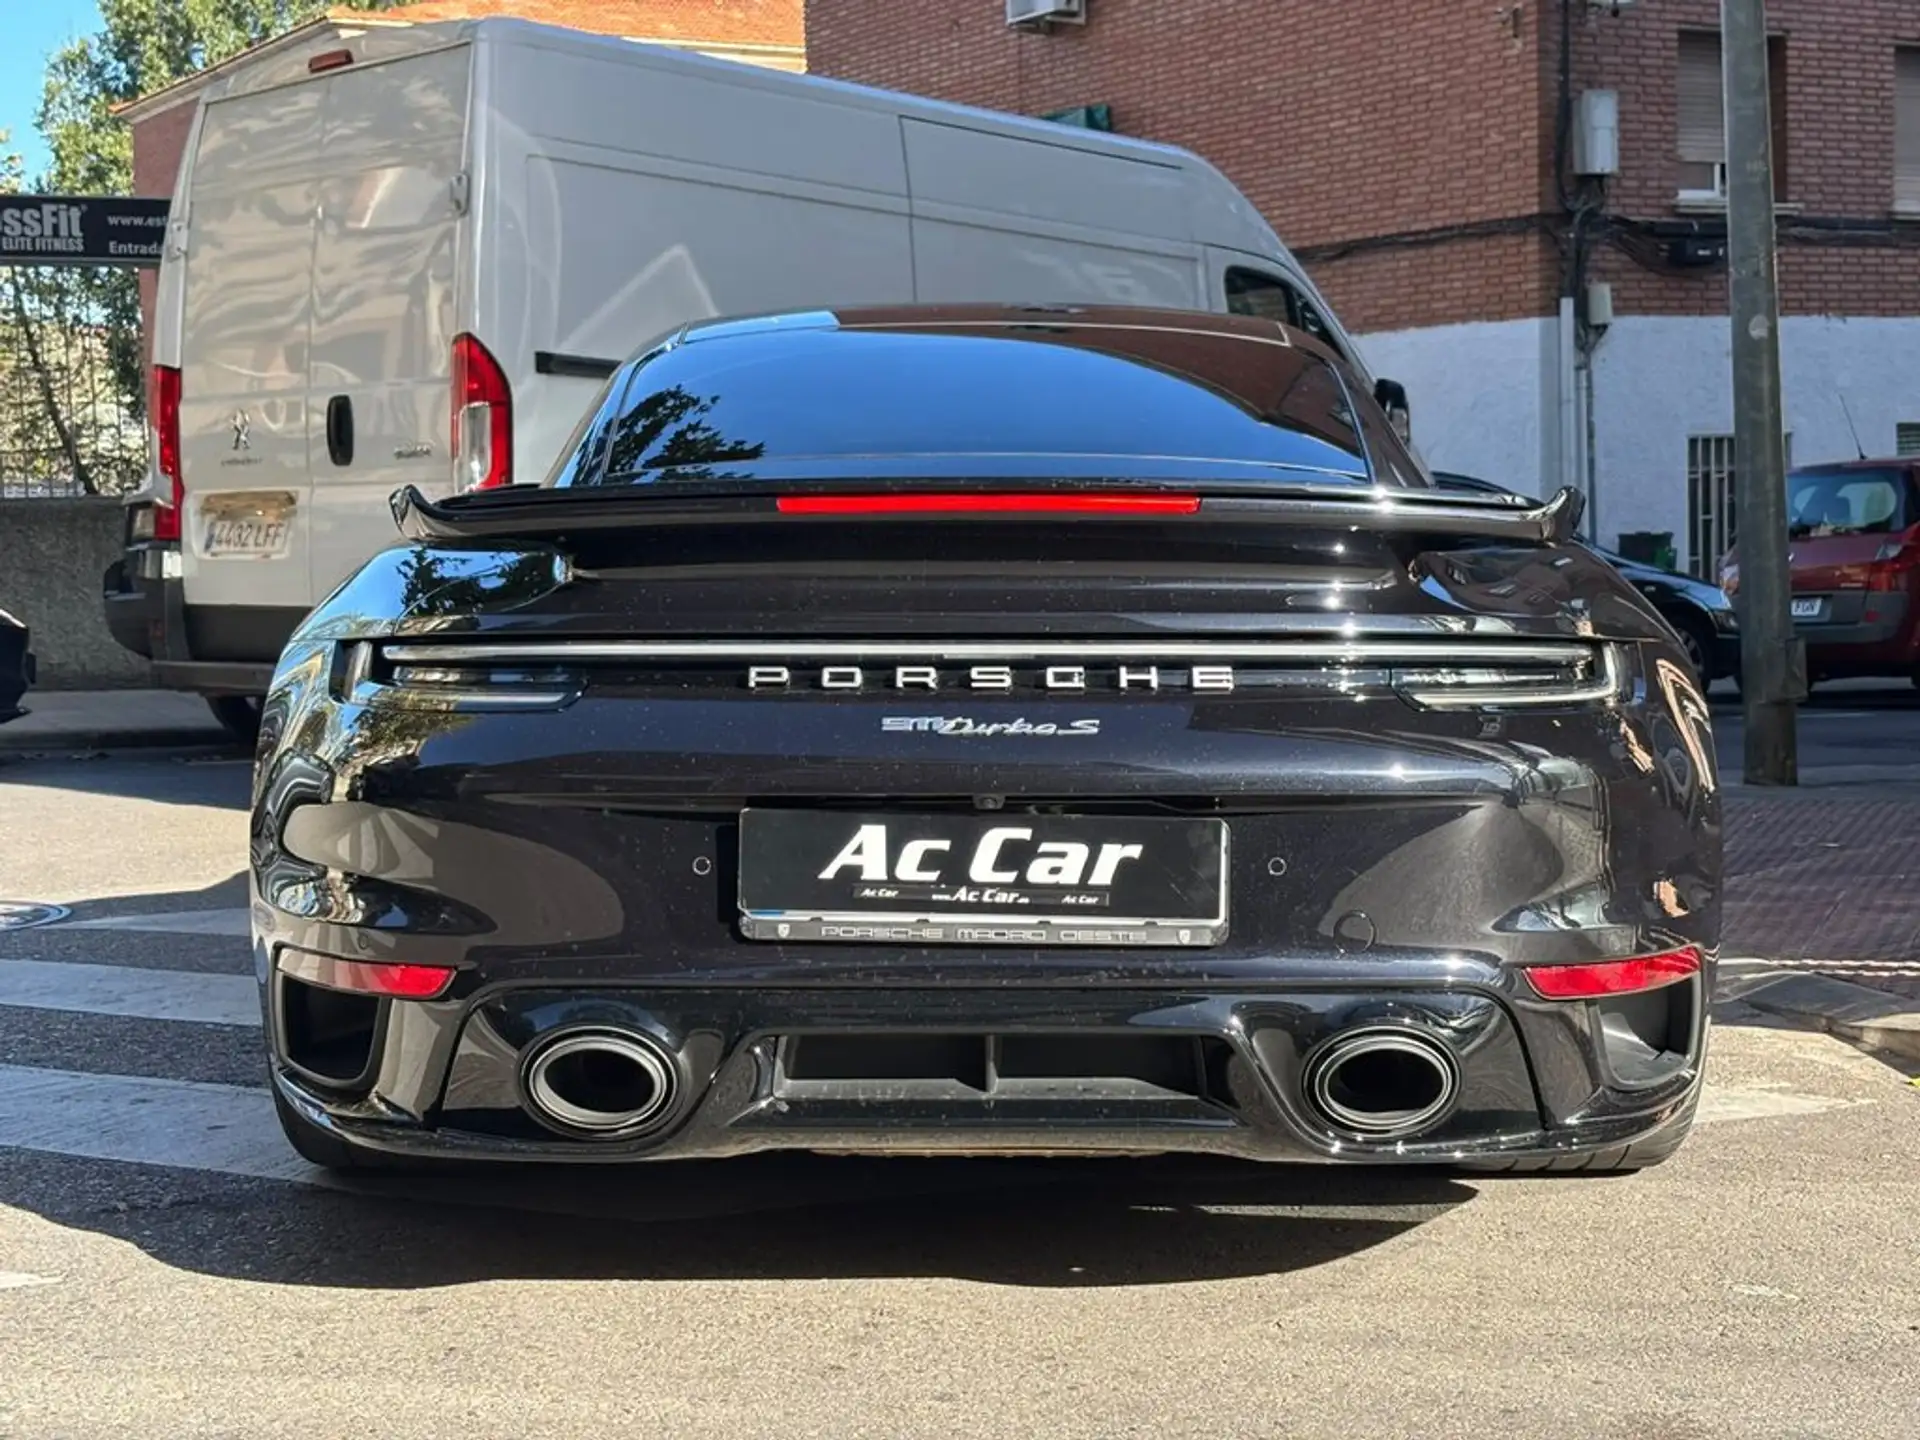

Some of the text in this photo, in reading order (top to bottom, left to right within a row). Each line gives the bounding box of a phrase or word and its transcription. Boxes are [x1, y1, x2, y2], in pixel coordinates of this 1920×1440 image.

[0, 204, 84, 237] ssFit
[2, 237, 84, 251] ELITE FITNESS
[748, 665, 1235, 690] PORSCHE
[817, 824, 1144, 887] Ac Car
[821, 926, 944, 938] PORSCHE
